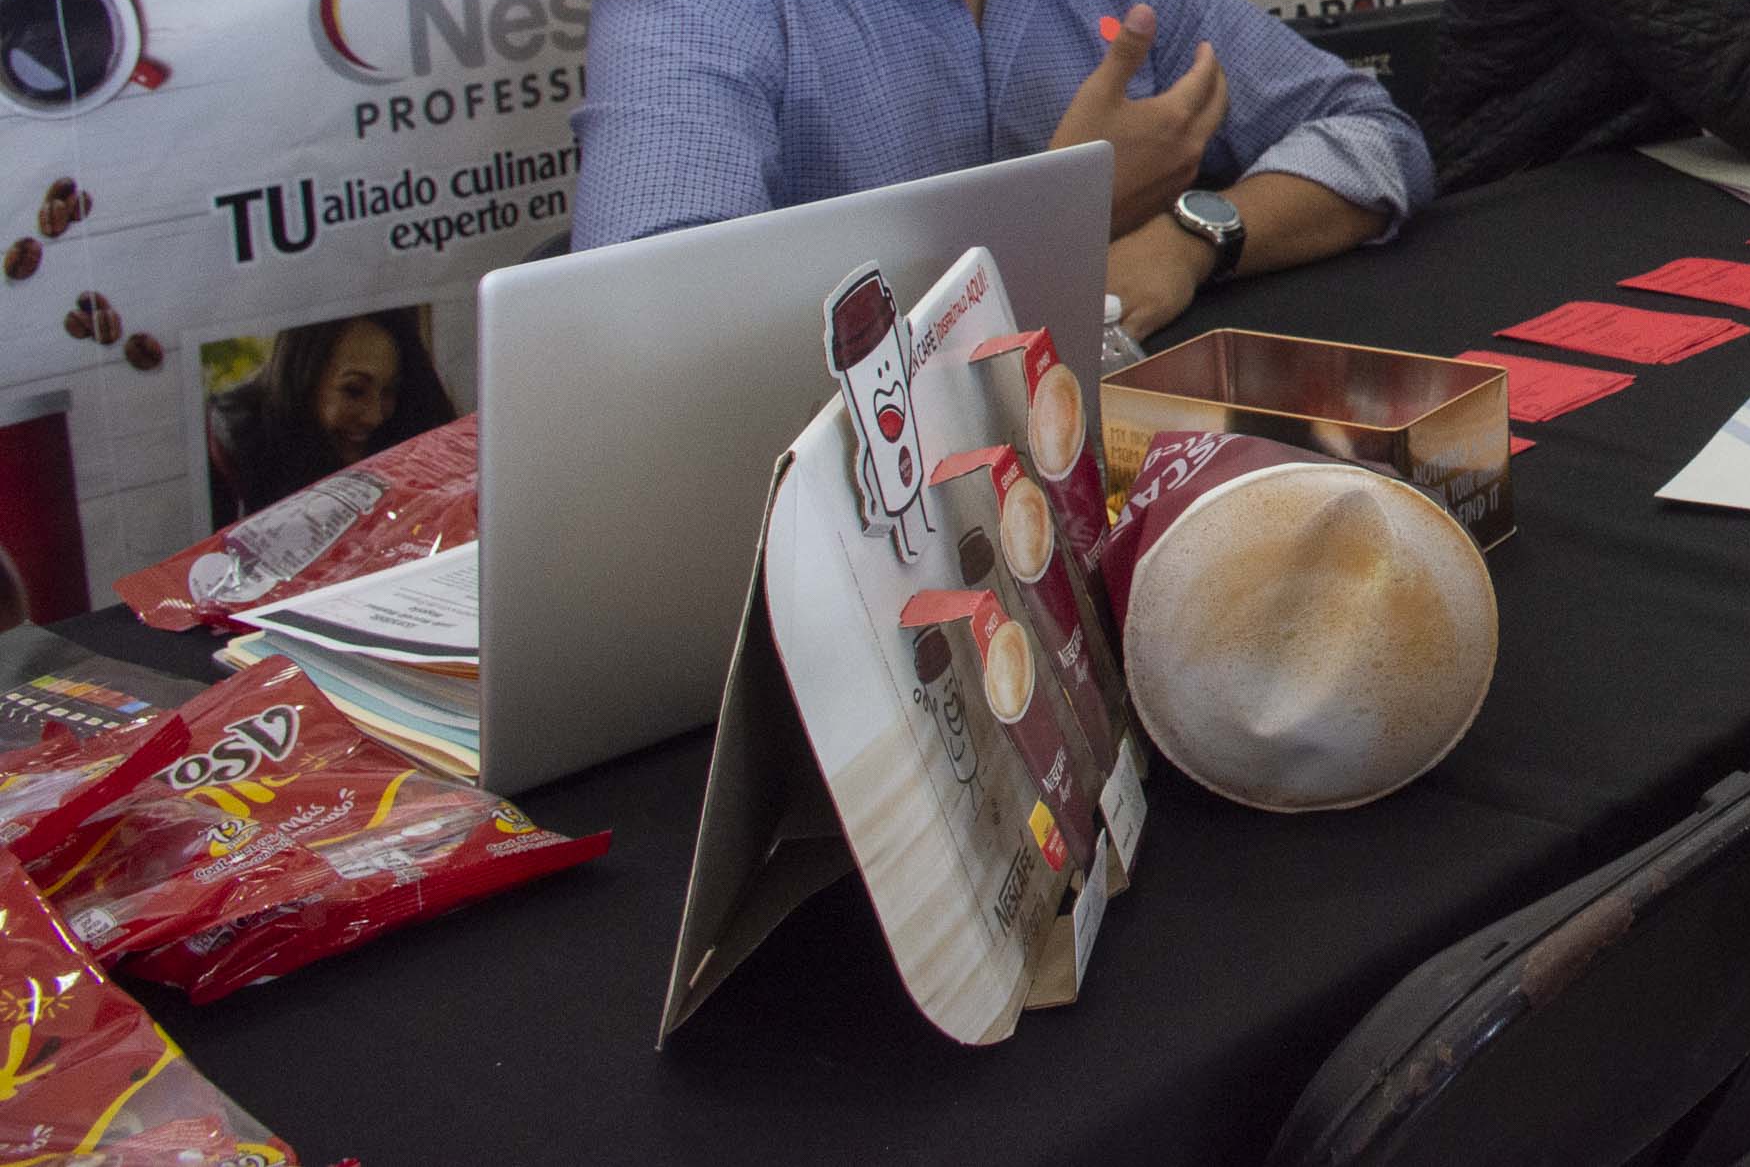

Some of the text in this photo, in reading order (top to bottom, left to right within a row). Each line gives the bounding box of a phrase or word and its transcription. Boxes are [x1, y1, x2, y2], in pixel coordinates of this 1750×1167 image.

[355, 65, 586, 139] PROFESSI
[215, 138, 583, 264] TU aliado culinari
[389, 189, 566, 252] experto en
